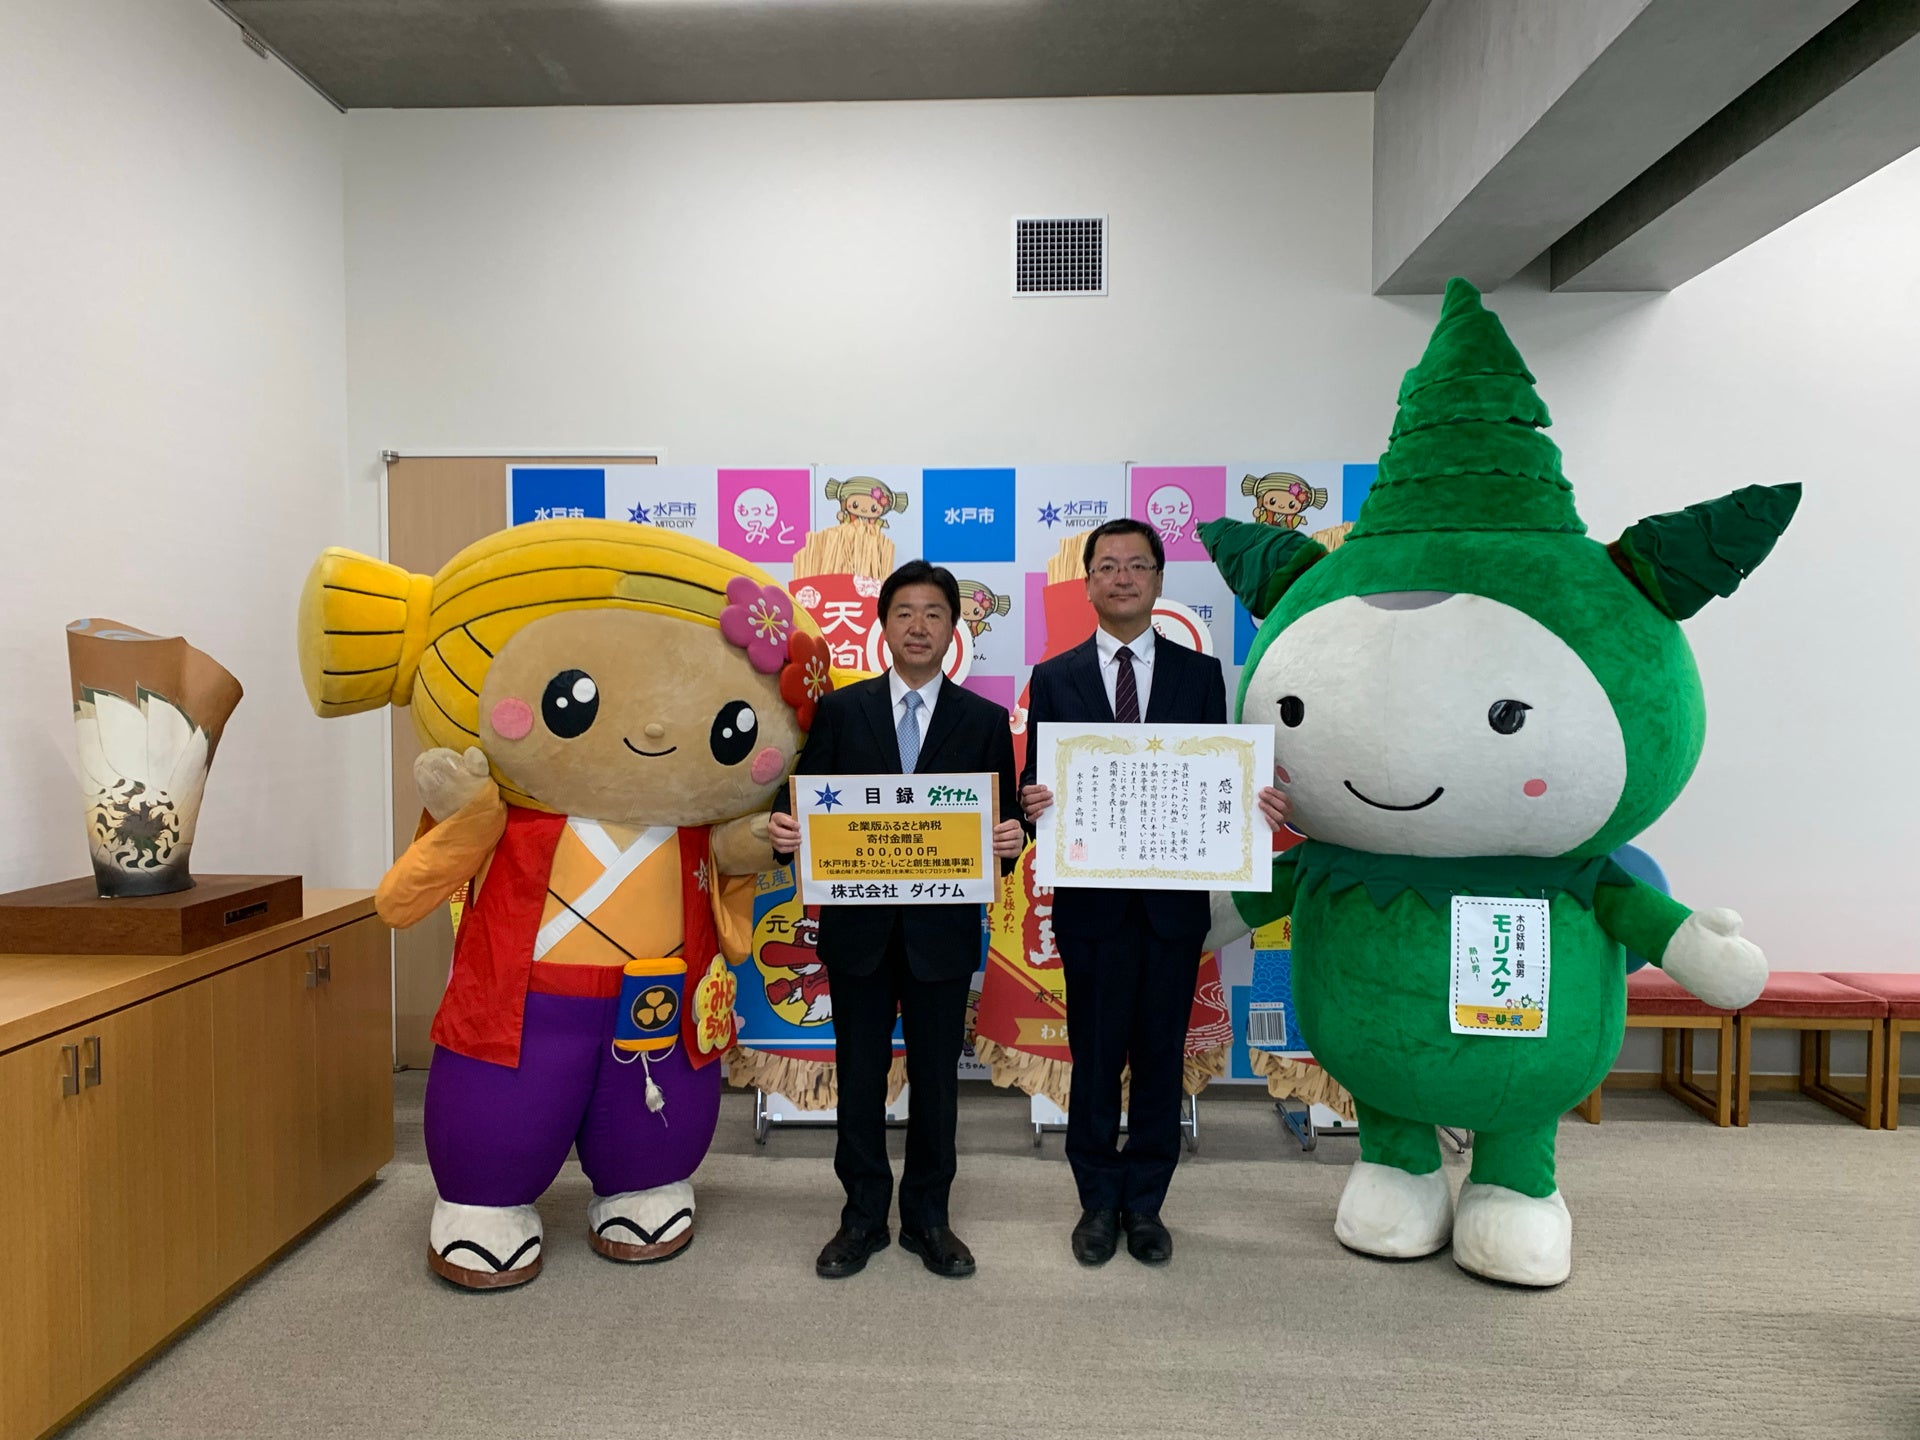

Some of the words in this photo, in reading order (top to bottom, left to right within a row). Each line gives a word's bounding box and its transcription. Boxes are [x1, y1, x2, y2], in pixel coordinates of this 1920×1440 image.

[653, 501, 696, 517] 水戸市
[737, 503, 775, 517] もっと
[944, 506, 995, 525] 水戸市
[1063, 500, 1108, 515] 水戸市
[1150, 502, 1189, 515] もっと
[655, 520, 676, 528] MITO
[677, 519, 694, 528] CITY
[1065, 519, 1086, 528] MITO
[1087, 518, 1106, 528] CITY
[745, 520, 796, 545] みと
[927, 785, 979, 807] ダイナム
[1216, 777, 1234, 835] 感謝状
[847, 820, 943, 832] 企業版ふるさと納税
[866, 833, 924, 845] 寄付金贈呈
[855, 846, 938, 859] 800,000円
[756, 868, 791, 891] 名産
[830, 883, 899, 899] 株式会社
[910, 882, 966, 899] ダイナム
[1515, 914, 1526, 979] 木の妖精・長男
[1490, 913, 1513, 998] モリスケ
